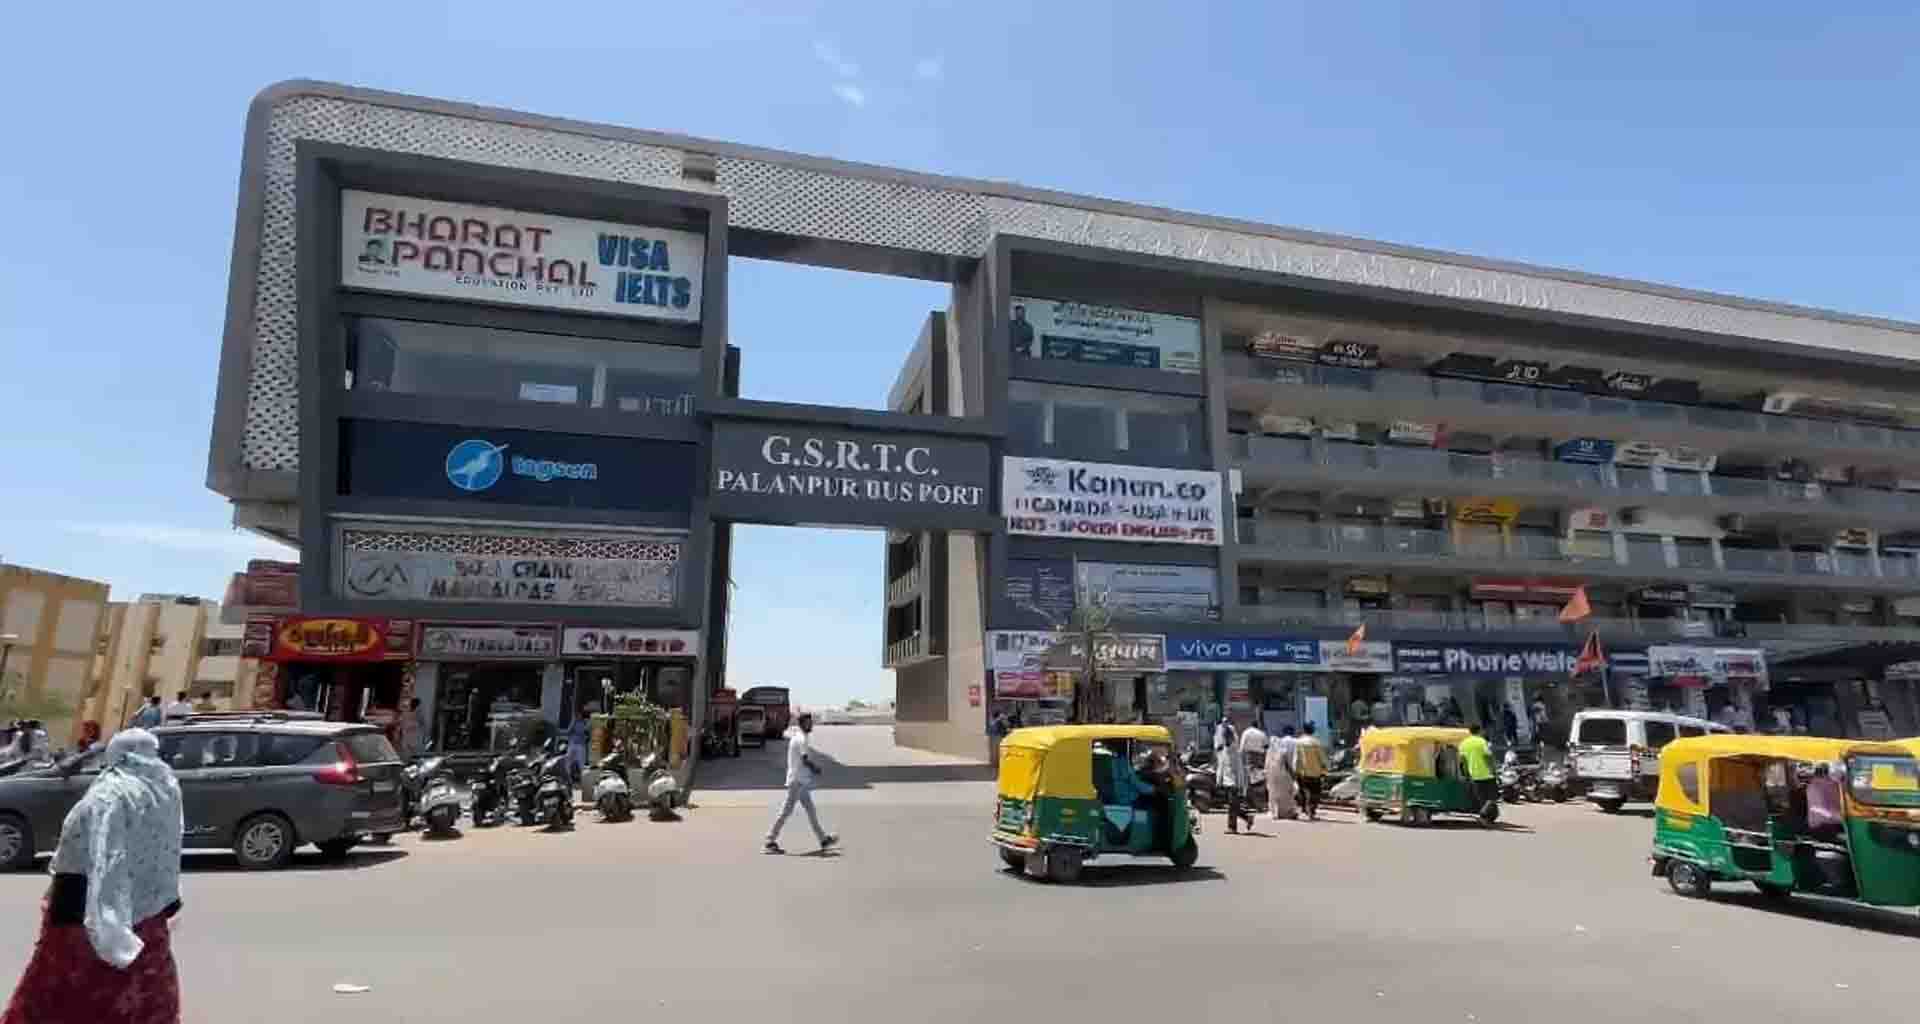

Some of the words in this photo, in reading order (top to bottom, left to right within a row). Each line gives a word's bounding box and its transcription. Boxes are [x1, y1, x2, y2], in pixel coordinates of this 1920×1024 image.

[363, 206, 552, 253] BHARAT
[596, 232, 671, 272] VISA
[614, 271, 692, 310] IELTS
[761, 434, 940, 477] G.S.R.T.C.
[717, 469, 859, 499] PALANPUR
[866, 478, 913, 502] BUS
[918, 482, 984, 506] PORT
[1031, 497, 1114, 517] CANADA
[1132, 504, 1170, 520] USA
[1178, 638, 1232, 657] vivo
